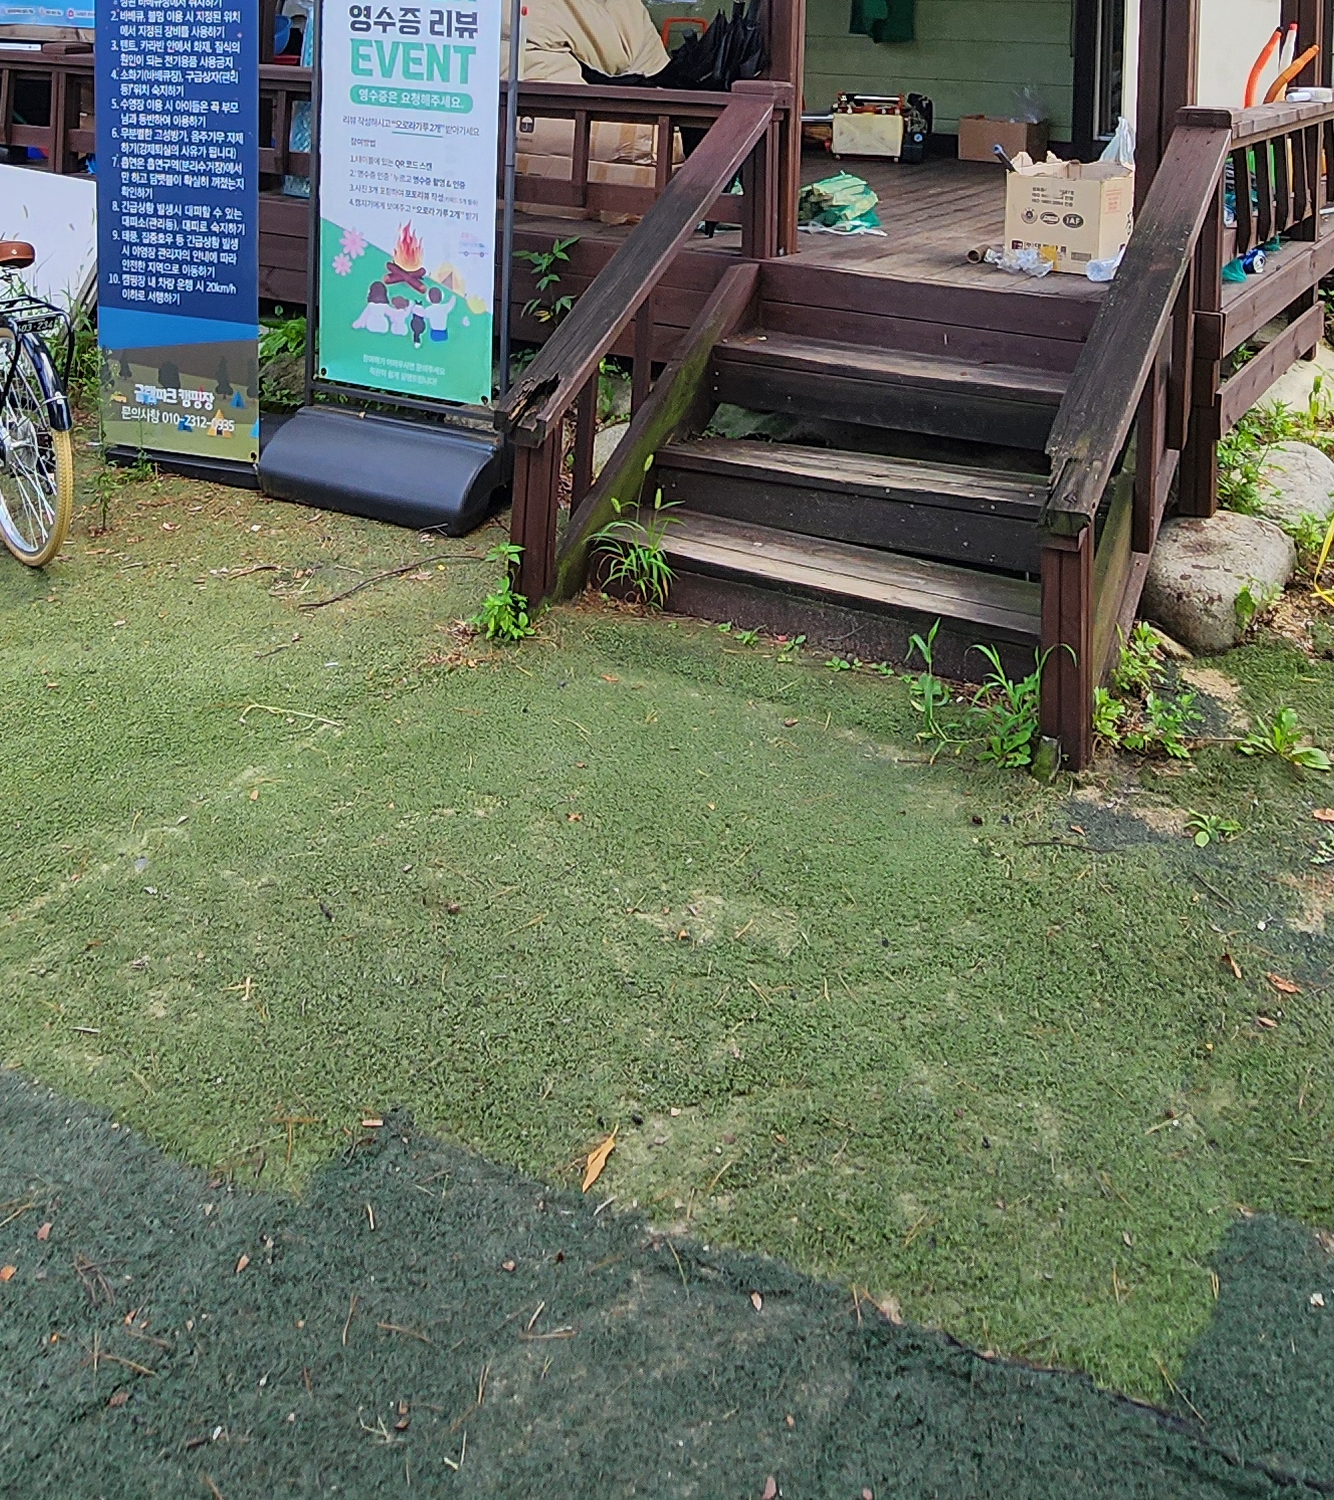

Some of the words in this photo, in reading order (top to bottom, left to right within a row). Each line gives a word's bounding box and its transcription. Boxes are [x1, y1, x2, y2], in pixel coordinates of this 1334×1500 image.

[111, 11, 118, 22] 2.
[148, 11, 164, 22] 불멍
[167, 11, 183, 22] 이용
[185, 11, 193, 23] 시
[196, 11, 221, 23] 지정된
[224, 11, 240, 23] 위치
[349, 5, 421, 35] 영수증
[430, 10, 478, 39] 리뷰
[120, 26, 136, 37] 에서
[138, 26, 162, 37] 지정된
[165, 26, 189, 37] 장비를
[191, 26, 225, 38] 사용하기
[111, 41, 119, 50] 3.
[140, 41, 164, 52] 카라반
[167, 41, 191, 52] 안에서
[215, 42, 240, 53] 질식의
[121, 54, 143, 66] 원인이
[146, 55, 162, 66] 되는
[165, 55, 197, 67] 전기용품
[200, 56, 233, 68] 사용금지
[349, 38, 476, 84] EVENT
[111, 70, 119, 79] 4.
[151, 85, 183, 96] 숙지하기
[111, 99, 119, 109] 5.
[120, 99, 144, 110] 수영장
[146, 100, 162, 111] 이용
[165, 100, 173, 112] 시
[175, 100, 208, 112] 아이들은
[211, 102, 219, 113] 꼭
[222, 102, 239, 113] 부모
[359, 89, 397, 103] 영수증은
[401, 93, 464, 109] 요청해주세요.
[121, 114, 136, 125] 님과
[139, 114, 171, 126] 동반하여
[173, 115, 206, 127] 이용하기
[343, 116, 356, 125] 리뷰
[358, 118, 390, 127] 작성하시고
[112, 128, 119, 138] 6.
[121, 128, 152, 140] 무분별한
[191, 131, 225, 143] 음주가무
[227, 132, 243, 144] 자제
[181, 145, 206, 158] 사유가
[209, 146, 236, 159] 됩니다)
[112, 157, 119, 167] 7.
[121, 157, 145, 169] 흡연은
[395, 160, 405, 169] QR
[406, 160, 418, 169] 코드
[420, 162, 432, 171] 스캔
[121, 172, 129, 183] 만
[131, 172, 147, 184] 하고
[184, 175, 209, 187] 확실히
[211, 176, 244, 189] 꺼졌는지
[413, 176, 431, 186] 영수증
[453, 180, 465, 189] 인증
[121, 186, 152, 199] 확인하기
[112, 201, 119, 211] 8.
[121, 201, 153, 214] 긴급상황
[157, 203, 181, 216] 발생시
[185, 205, 211, 218] 대피할
[213, 207, 222, 218] 수
[225, 208, 243, 219] 있는
[182, 220, 208, 232] 대피로
[211, 222, 245, 235] 숙지하기
[112, 231, 120, 240] 9.
[142, 232, 173, 244] 집중호우
[176, 234, 184, 246] 등
[187, 235, 219, 248] 긴급상황
[222, 237, 239, 250] 발생
[121, 245, 129, 256] 시
[132, 246, 155, 258] 야영장
[158, 248, 190, 260] 관리자의
[193, 251, 217, 263] 안내에
[220, 252, 237, 265] 따라
[122, 260, 145, 272] 안전한
[147, 262, 180, 274] 지역으로
[182, 265, 215, 278] 이동하기
[109, 274, 120, 284] 10.
[122, 274, 145, 287] 캠핑장
[148, 276, 155, 288] 내
[158, 278, 175, 289] 차량
[177, 279, 193, 291] 운행
[195, 281, 204, 292] 시
[206, 282, 236, 294] 20km/h
[122, 289, 146, 301] 이하로
[147, 291, 180, 305] 서행하기
[178, 388, 215, 410] 캠핑장
[121, 406, 160, 423] 문의사항
[162, 412, 234, 431] 010-2312-0935
